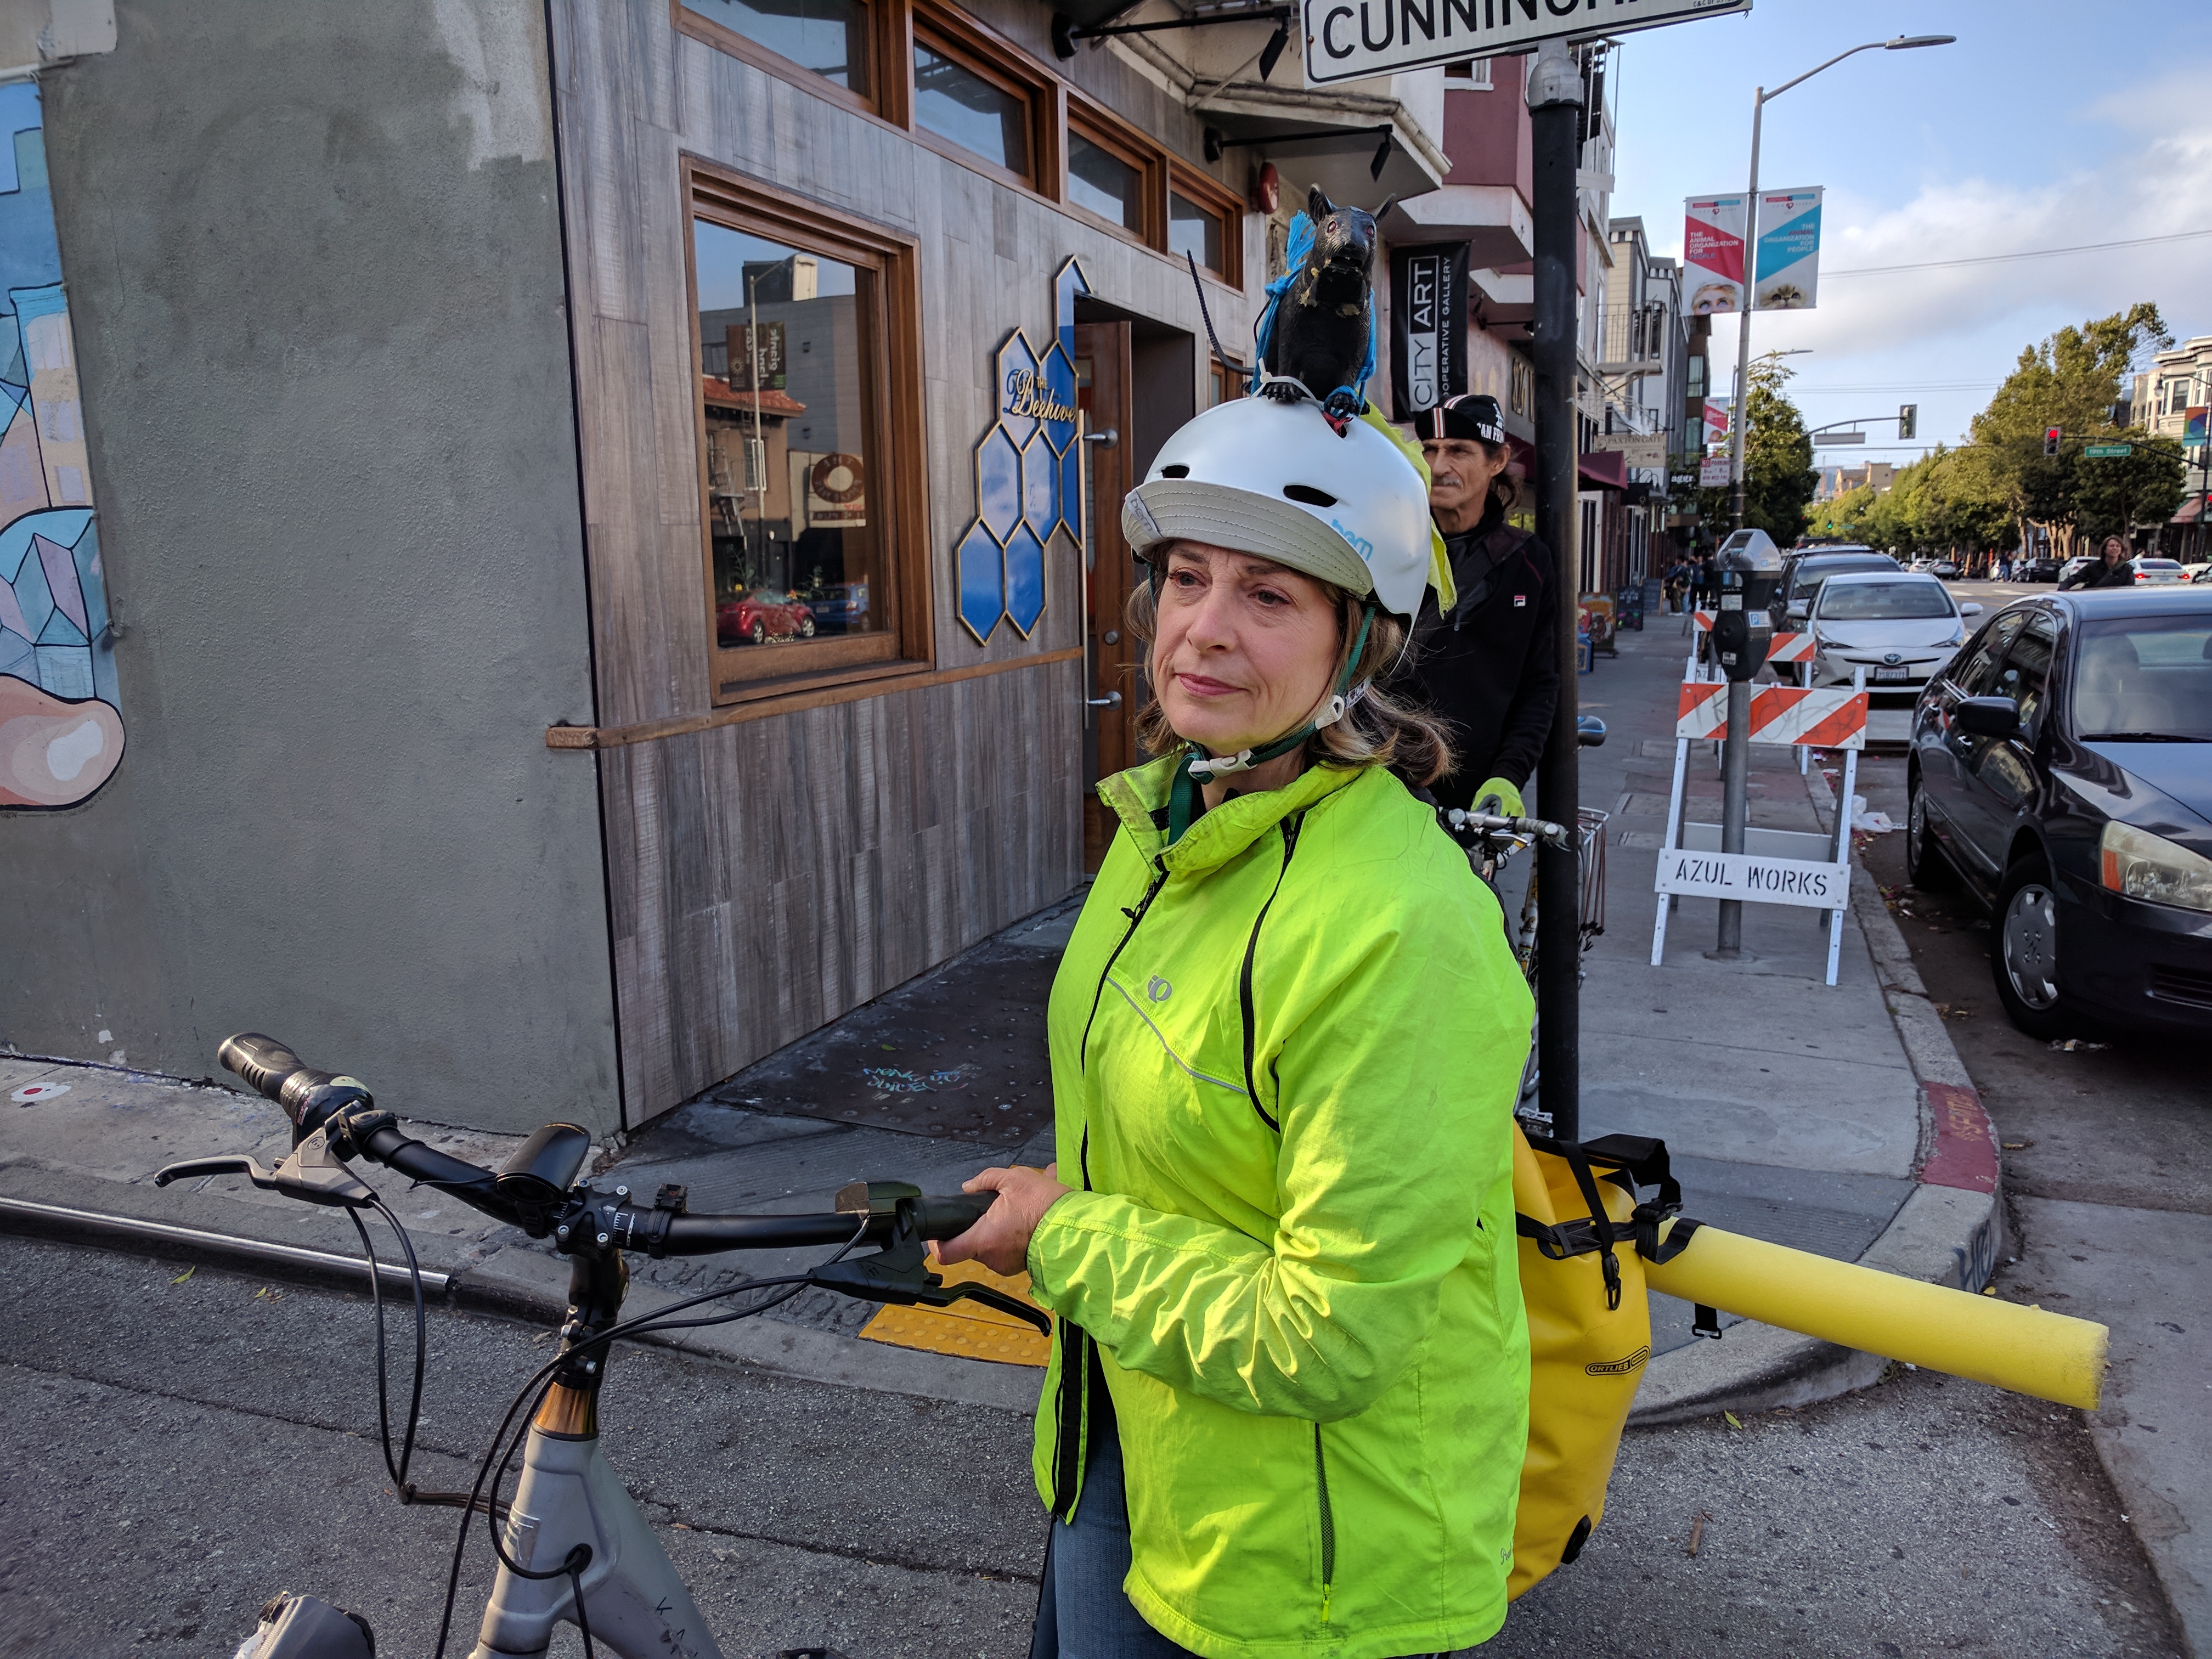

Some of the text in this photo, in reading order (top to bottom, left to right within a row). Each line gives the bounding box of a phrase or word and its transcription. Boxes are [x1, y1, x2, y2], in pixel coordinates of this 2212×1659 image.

[1689, 240, 1739, 248] ORGANIZATION
[1764, 235, 1815, 244] ORGANIZATION
[1413, 262, 1433, 405] CITY ART
[1441, 257, 1451, 397] OPERATIVE GALLERY
[1012, 368, 1077, 423] Beehive
[1036, 376, 1048, 390] THE
[1675, 858, 1828, 897] AZUL WORKS
[1590, 1362, 1629, 1372] ORTLIEB
